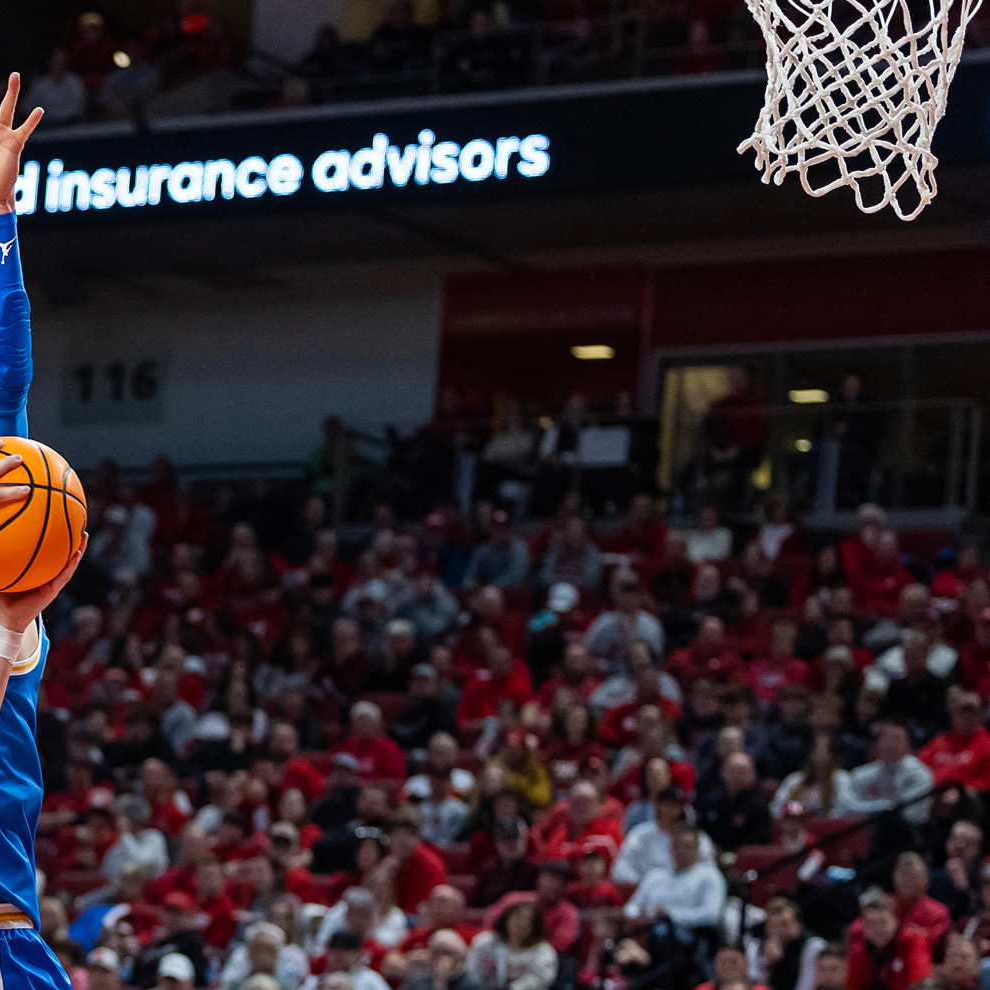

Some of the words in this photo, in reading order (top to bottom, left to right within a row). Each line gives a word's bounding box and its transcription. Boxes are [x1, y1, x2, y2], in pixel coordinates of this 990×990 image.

[44, 158, 304, 213] insurance
[311, 128, 551, 193] advisors
[73, 359, 159, 403] 116
